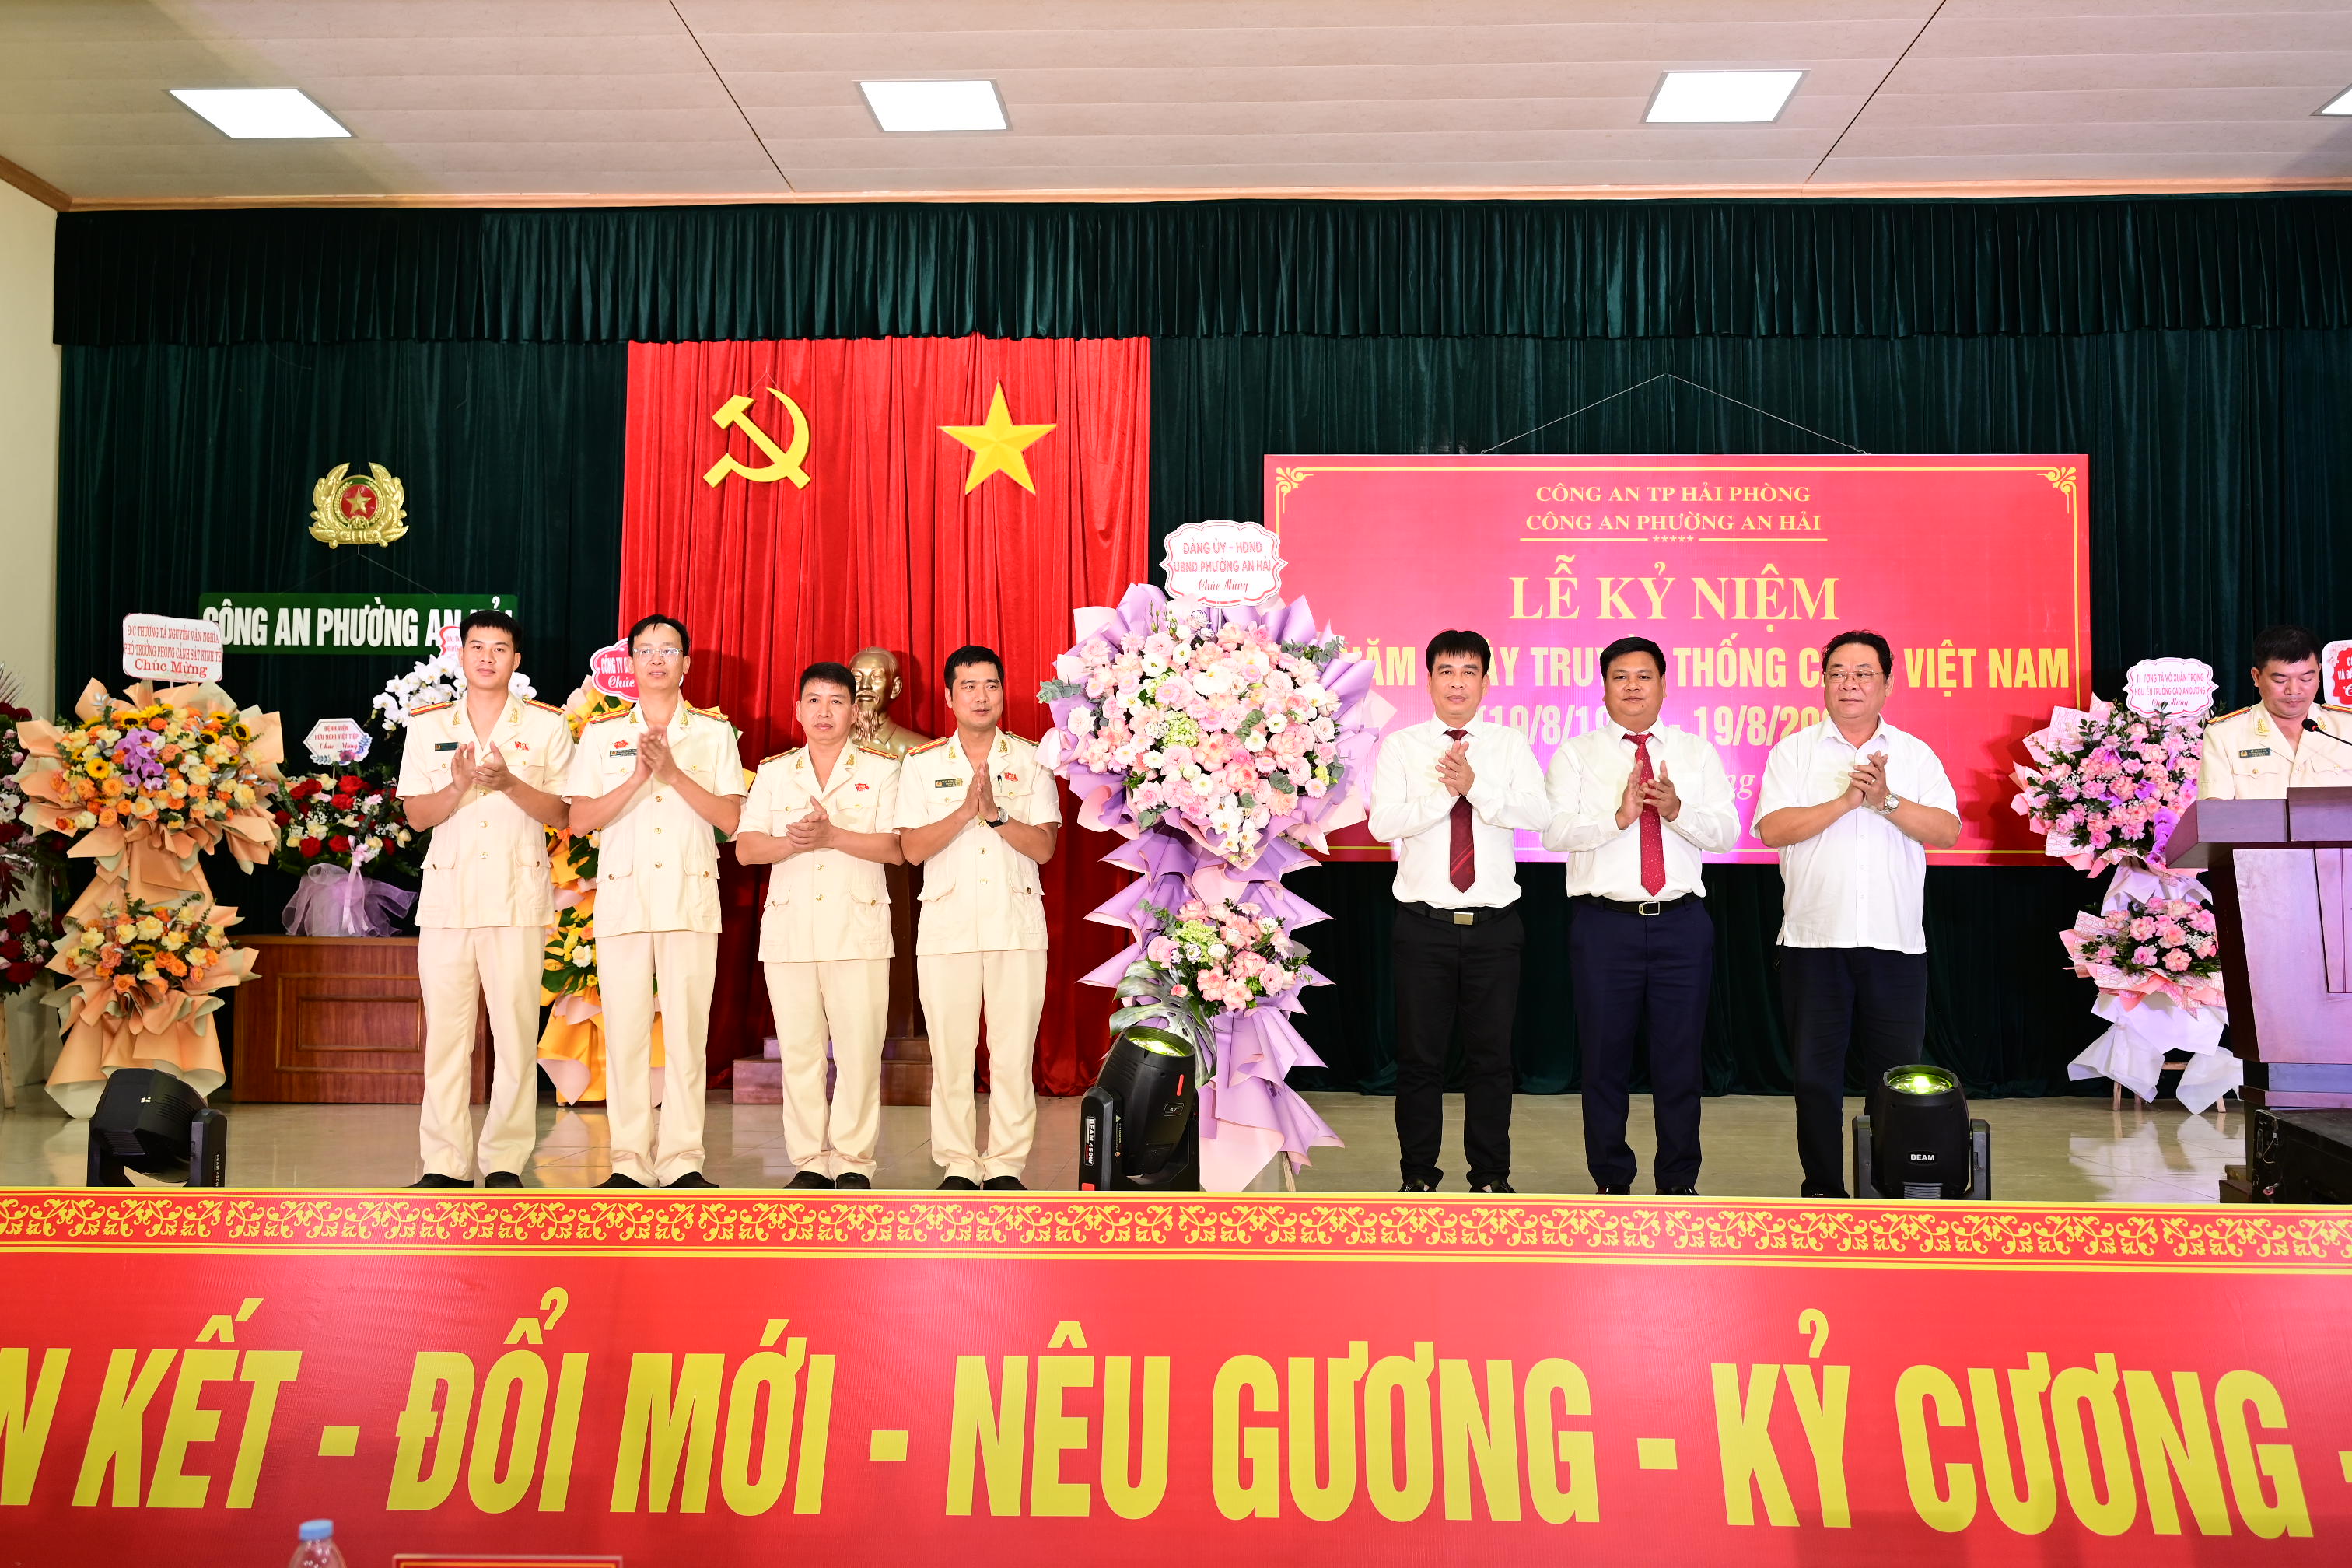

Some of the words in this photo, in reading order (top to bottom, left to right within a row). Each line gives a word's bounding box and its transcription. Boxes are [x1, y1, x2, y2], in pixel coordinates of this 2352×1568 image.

[1535, 482, 1602, 502] CÔNG
[1608, 486, 1640, 502] AN
[1646, 486, 1675, 502] TP
[1681, 481, 1723, 502] HẢI
[1729, 482, 1811, 502] PHÒNG
[1526, 511, 1592, 530] CÔNG
[1599, 515, 1630, 530] AN
[1636, 510, 1734, 530] PHƯỜNG
[1741, 515, 1773, 530] AN
[1779, 510, 1822, 530] HẢI
[1183, 537, 1211, 555] ĐẢNG
[1213, 537, 1227, 554] ỦY
[1174, 561, 1198, 573] UBND
[1200, 557, 1239, 572] PHƯỜNG
[1241, 560, 1255, 572] AN
[1256, 555, 1272, 572] HẢI
[1508, 554, 1580, 619] LỄ
[1595, 561, 1676, 620] KỶ
[1691, 563, 1839, 633] NIỆM
[273, 607, 311, 646] AN
[316, 597, 418, 647] PHƯỜNG
[201, 649, 215, 662] KINH
[1339, 637, 1416, 686] ĂM
[1672, 633, 1787, 688] THỐNG
[1903, 639, 1977, 697] VIỆT
[1989, 648, 2070, 688] NAM
[135, 658, 167, 672] Chúc
[170, 661, 208, 678] Mừng
[607, 675, 635, 688] Chúc
[71, 1297, 303, 1509] KẾT
[386, 1287, 590, 1514] ĐỔI
[609, 1318, 836, 1517] MỚI
[945, 1321, 1171, 1521] NÊU
[1211, 1340, 1600, 1525] GƯƠNG
[1710, 1308, 1852, 1528] KỶ
[1895, 1351, 2315, 1540] CƯƠNG
